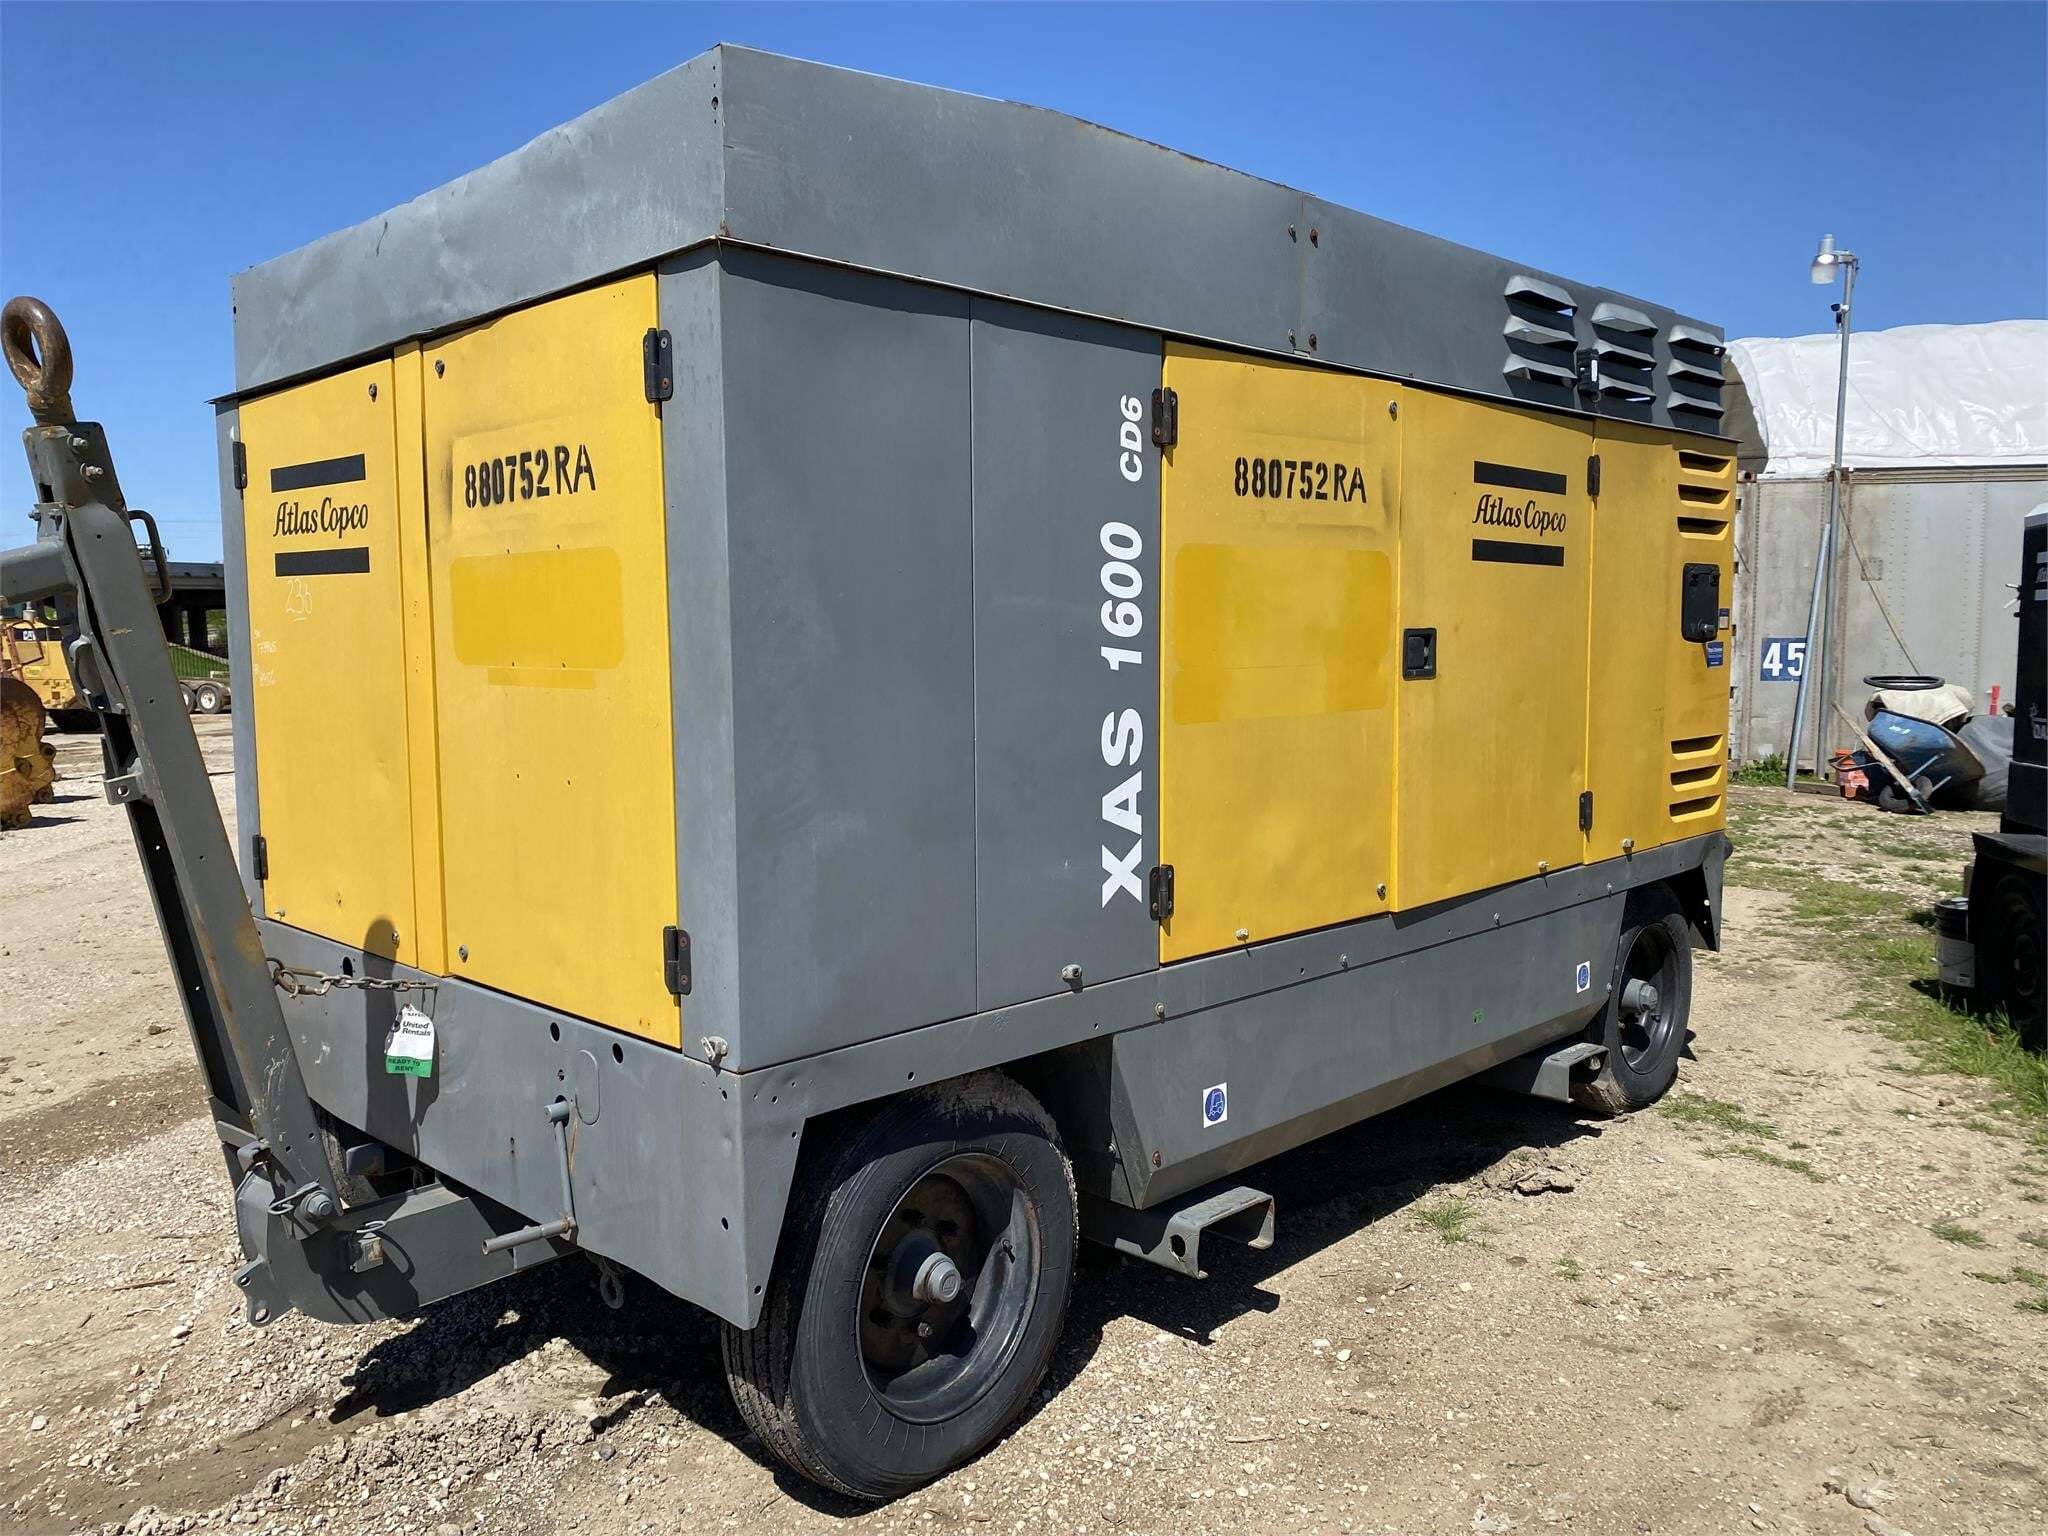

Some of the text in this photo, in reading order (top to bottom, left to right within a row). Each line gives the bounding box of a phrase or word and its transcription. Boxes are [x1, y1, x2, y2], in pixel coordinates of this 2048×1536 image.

[465, 445, 596, 508] 880752RA
[1234, 457, 1367, 503] 880752RA
[273, 497, 369, 539] Atlas Copco
[1472, 494, 1567, 536] Atlas Copco
[1100, 394, 1144, 909] XAS 1600 CD6
[1762, 642, 1806, 677] 45
[402, 1021, 430, 1029] United
[402, 1027, 431, 1037] Rentals
